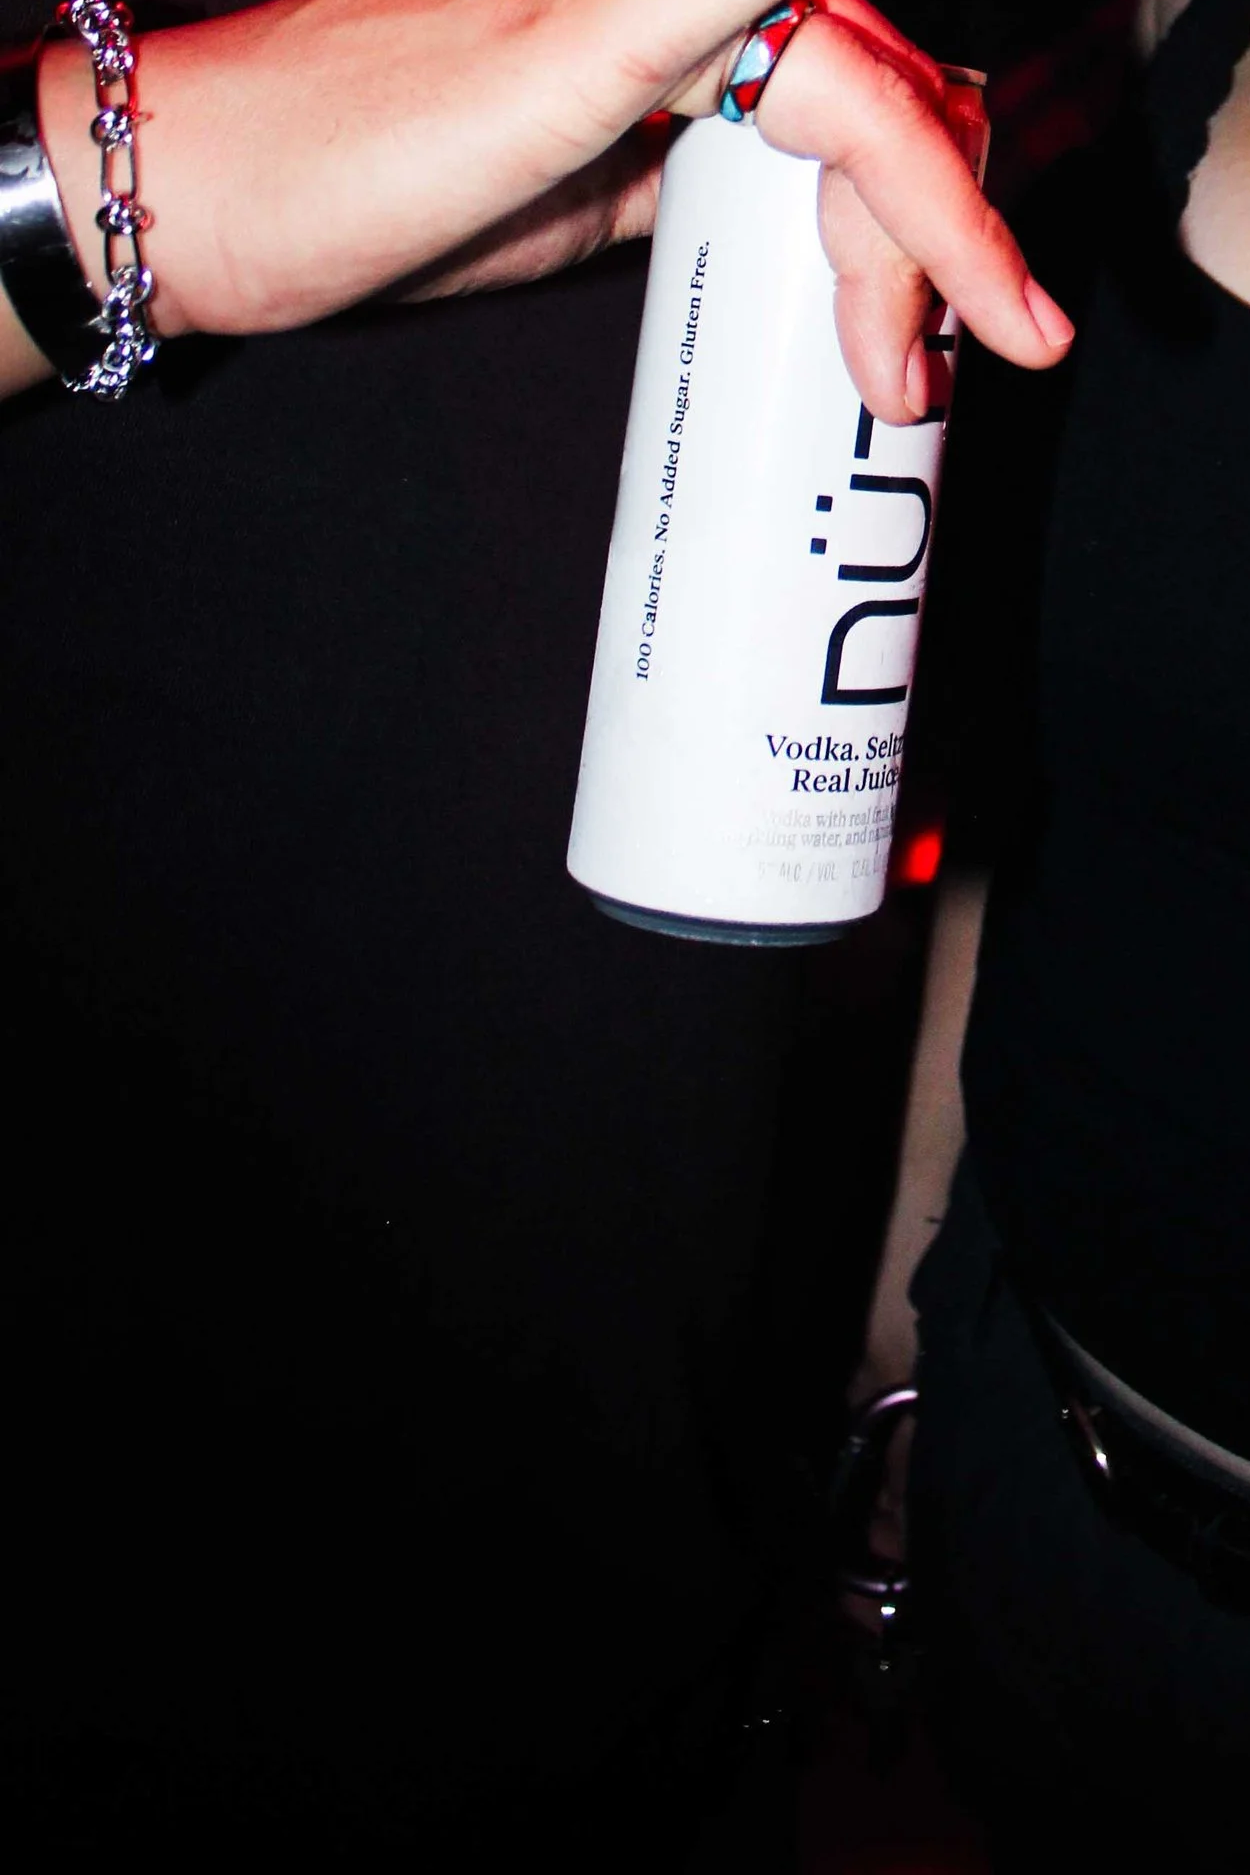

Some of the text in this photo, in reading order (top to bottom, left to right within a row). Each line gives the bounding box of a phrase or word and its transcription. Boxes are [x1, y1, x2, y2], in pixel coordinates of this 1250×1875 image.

[636, 240, 710, 681] 100 Calories. No Added Sugar. Gluten Free.
[765, 733, 860, 761] Vodka.
[791, 767, 851, 793] Real
[815, 809, 846, 828] with
[845, 825, 867, 845] and
